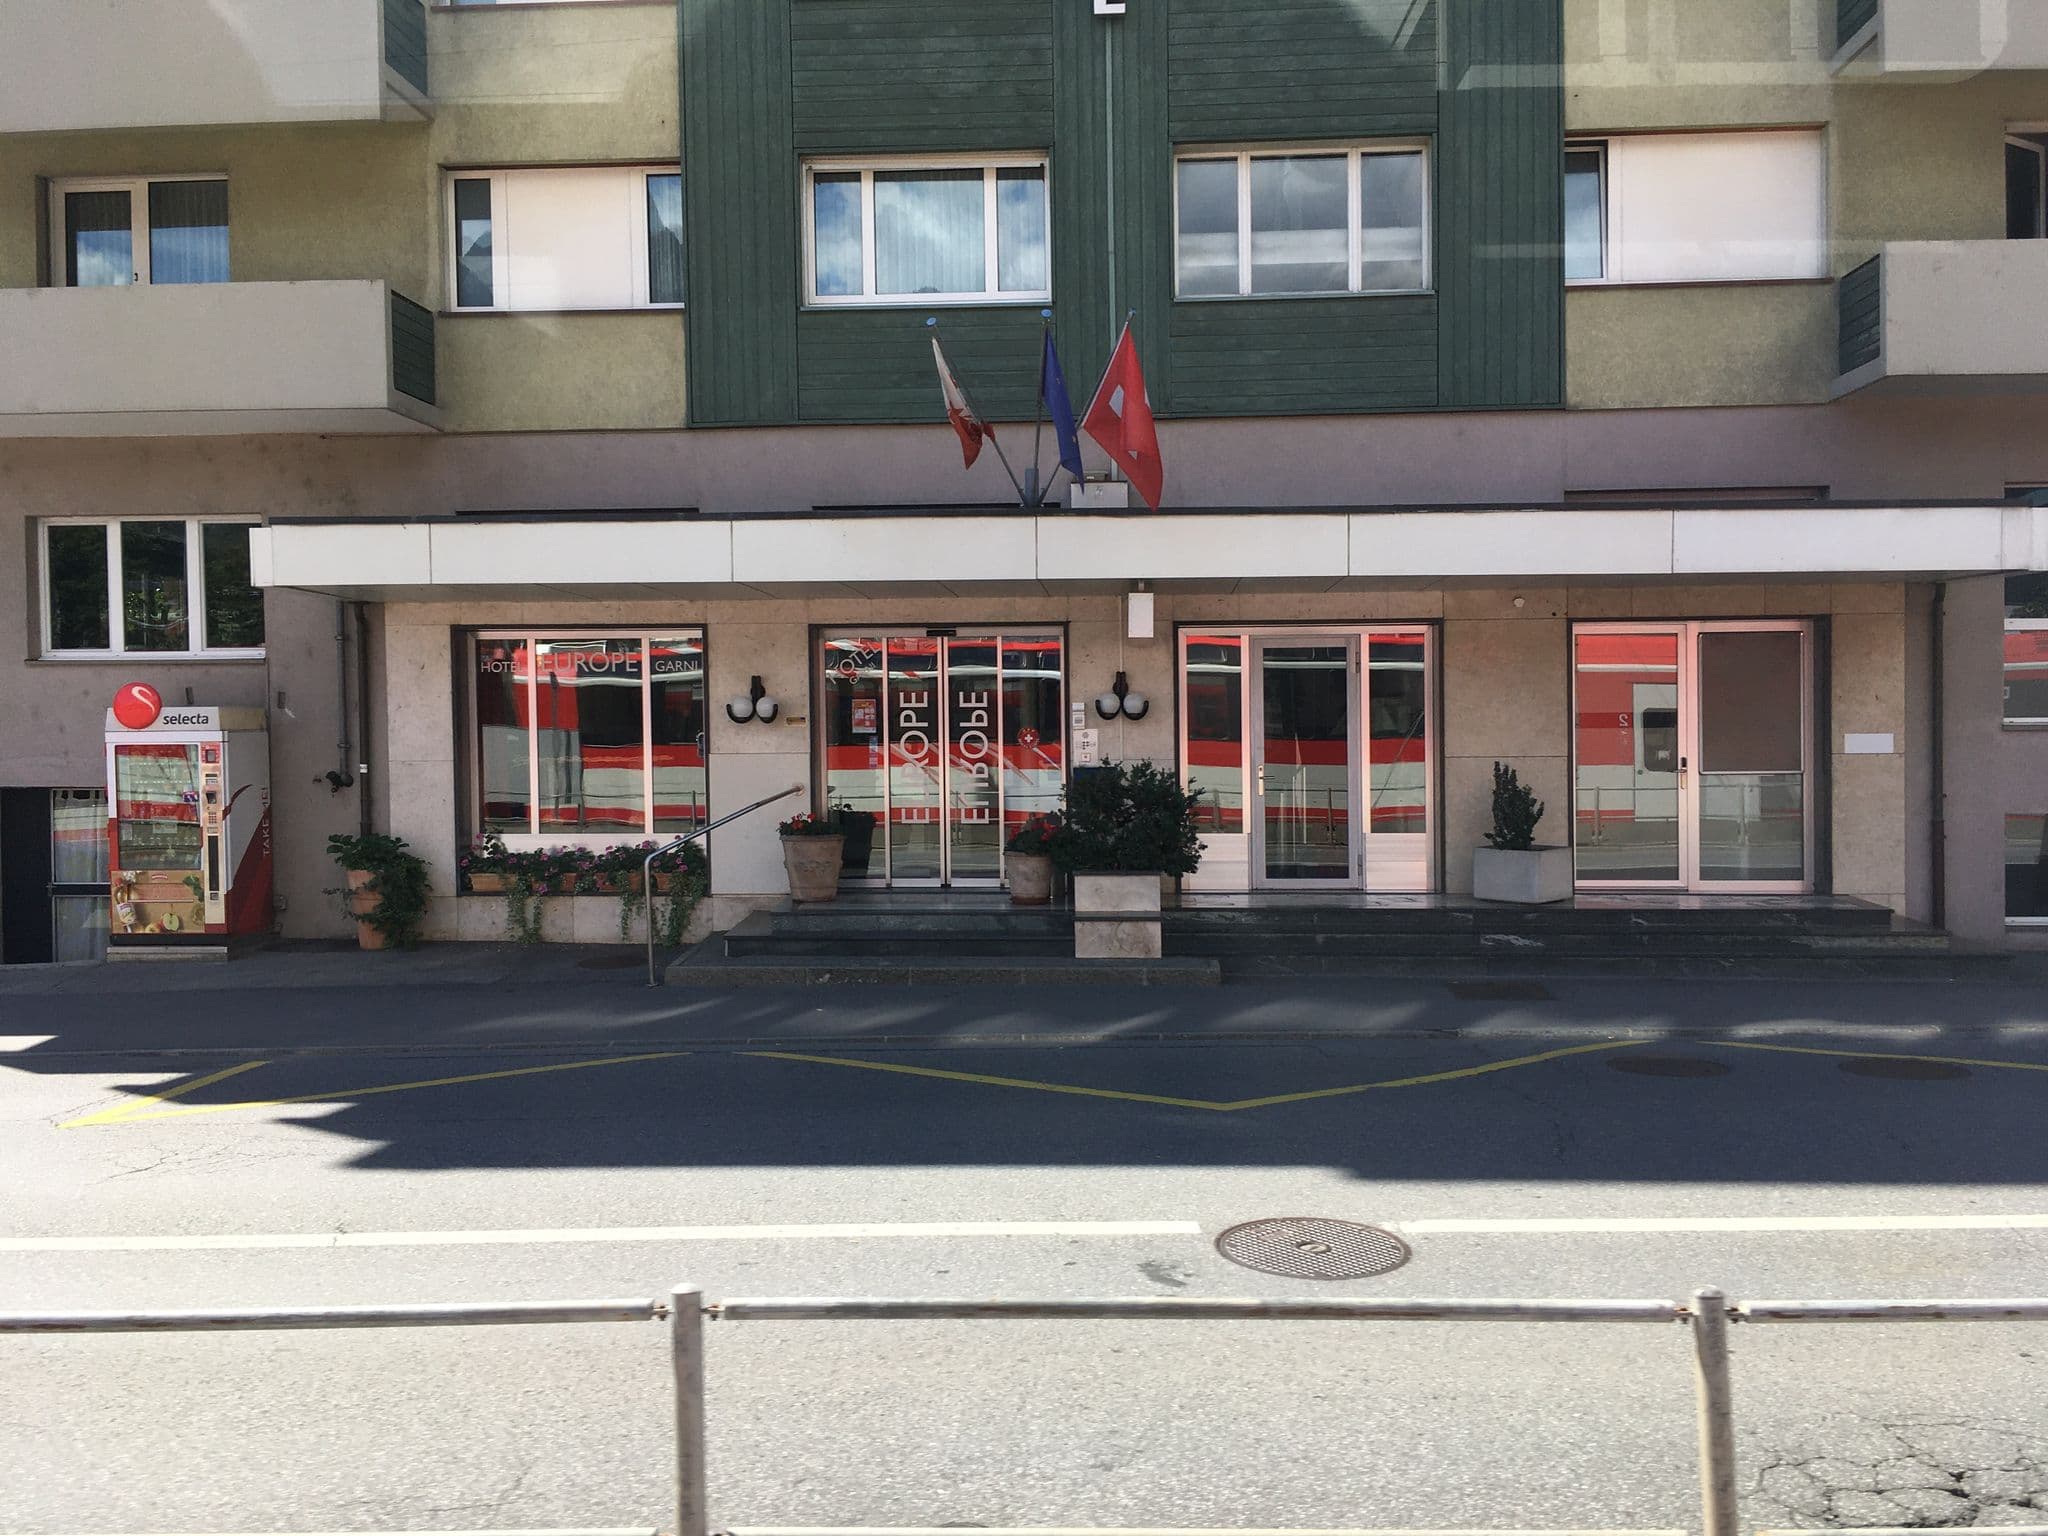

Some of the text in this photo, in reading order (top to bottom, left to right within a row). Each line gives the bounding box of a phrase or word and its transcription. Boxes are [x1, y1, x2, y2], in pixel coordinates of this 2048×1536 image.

[480, 651, 698, 674] HOTEL EUROPE GARNI
[828, 642, 882, 685] OTEL
[163, 713, 209, 725] selecta
